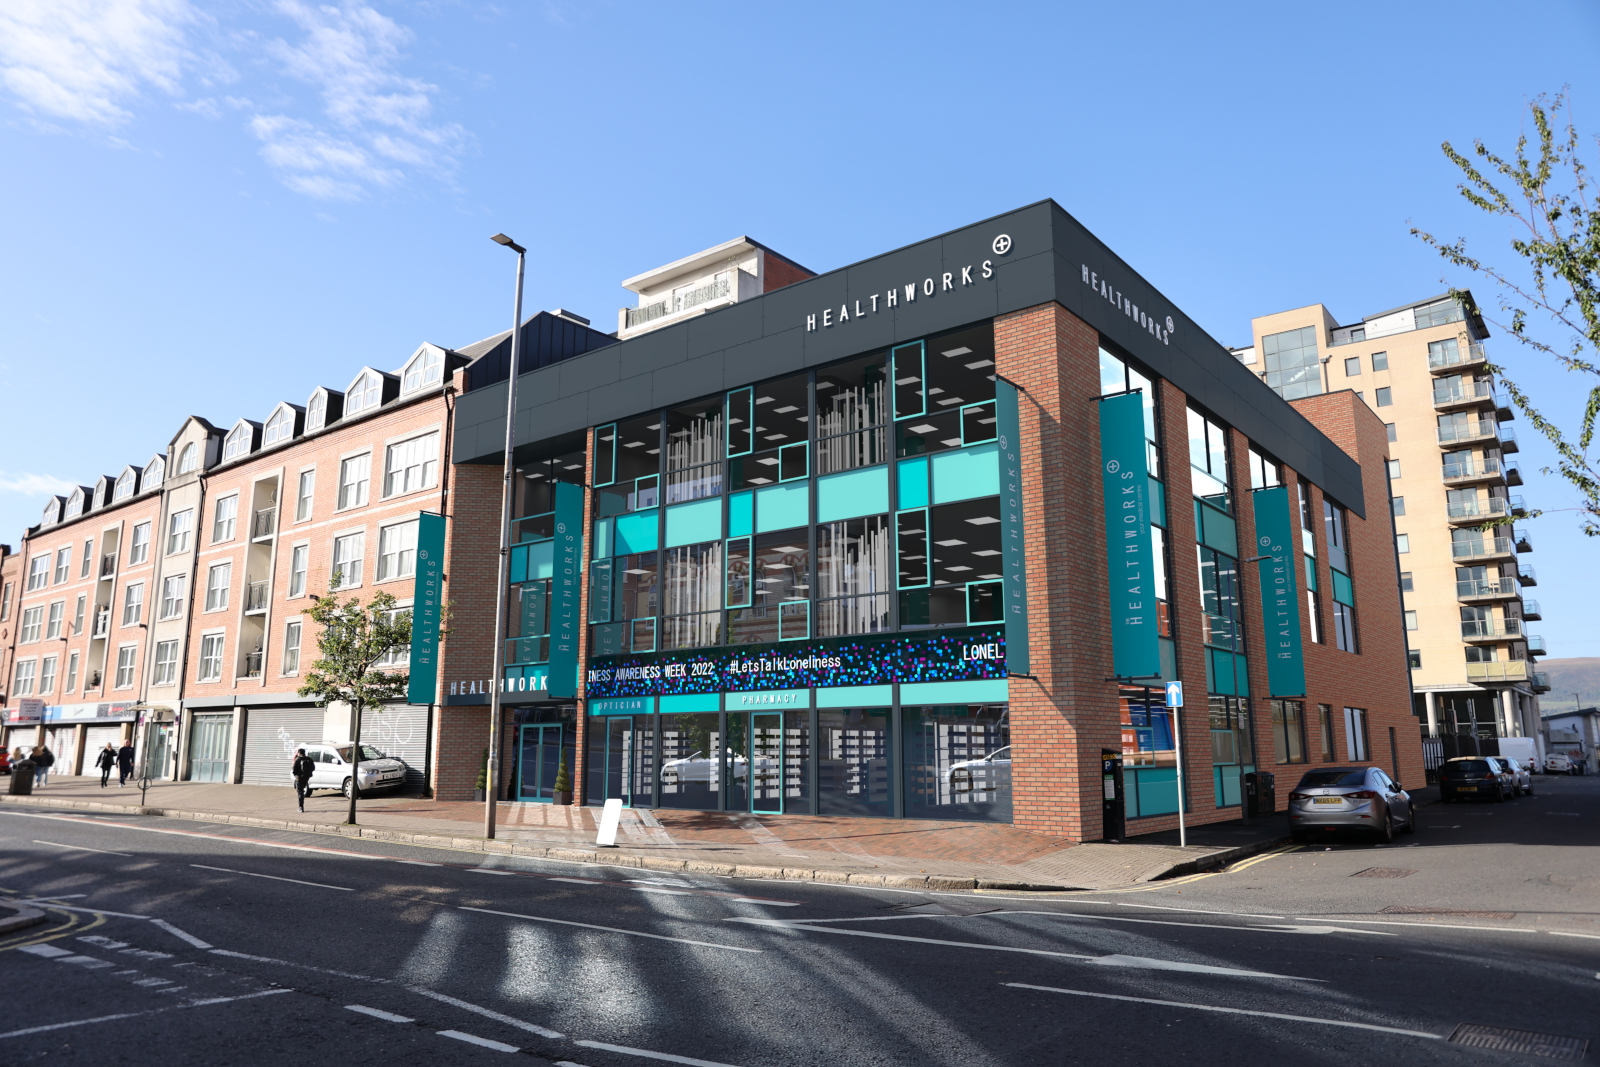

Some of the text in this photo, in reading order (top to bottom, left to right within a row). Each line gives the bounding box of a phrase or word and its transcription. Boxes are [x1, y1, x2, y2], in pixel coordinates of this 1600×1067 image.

[807, 260, 993, 332] HEALTHWORKS
[1081, 264, 1169, 346] HEALTHWORKS
[1007, 453, 1021, 614] HEALTHWORKS
[1121, 471, 1143, 625] HEALTHWORKS
[421, 560, 436, 664] HEALTHWORKS
[561, 535, 574, 652] HEALTHWORKS
[1272, 545, 1292, 659] HEALTHWORKS
[588, 643, 1004, 682] INESS AWARENESS WEEK 2022 #LetsTalkLoneliness LONEL
[742, 693, 797, 705] PHARMACY
[598, 700, 641, 710] OPTICIAN
[1104, 761, 1111, 770] P
